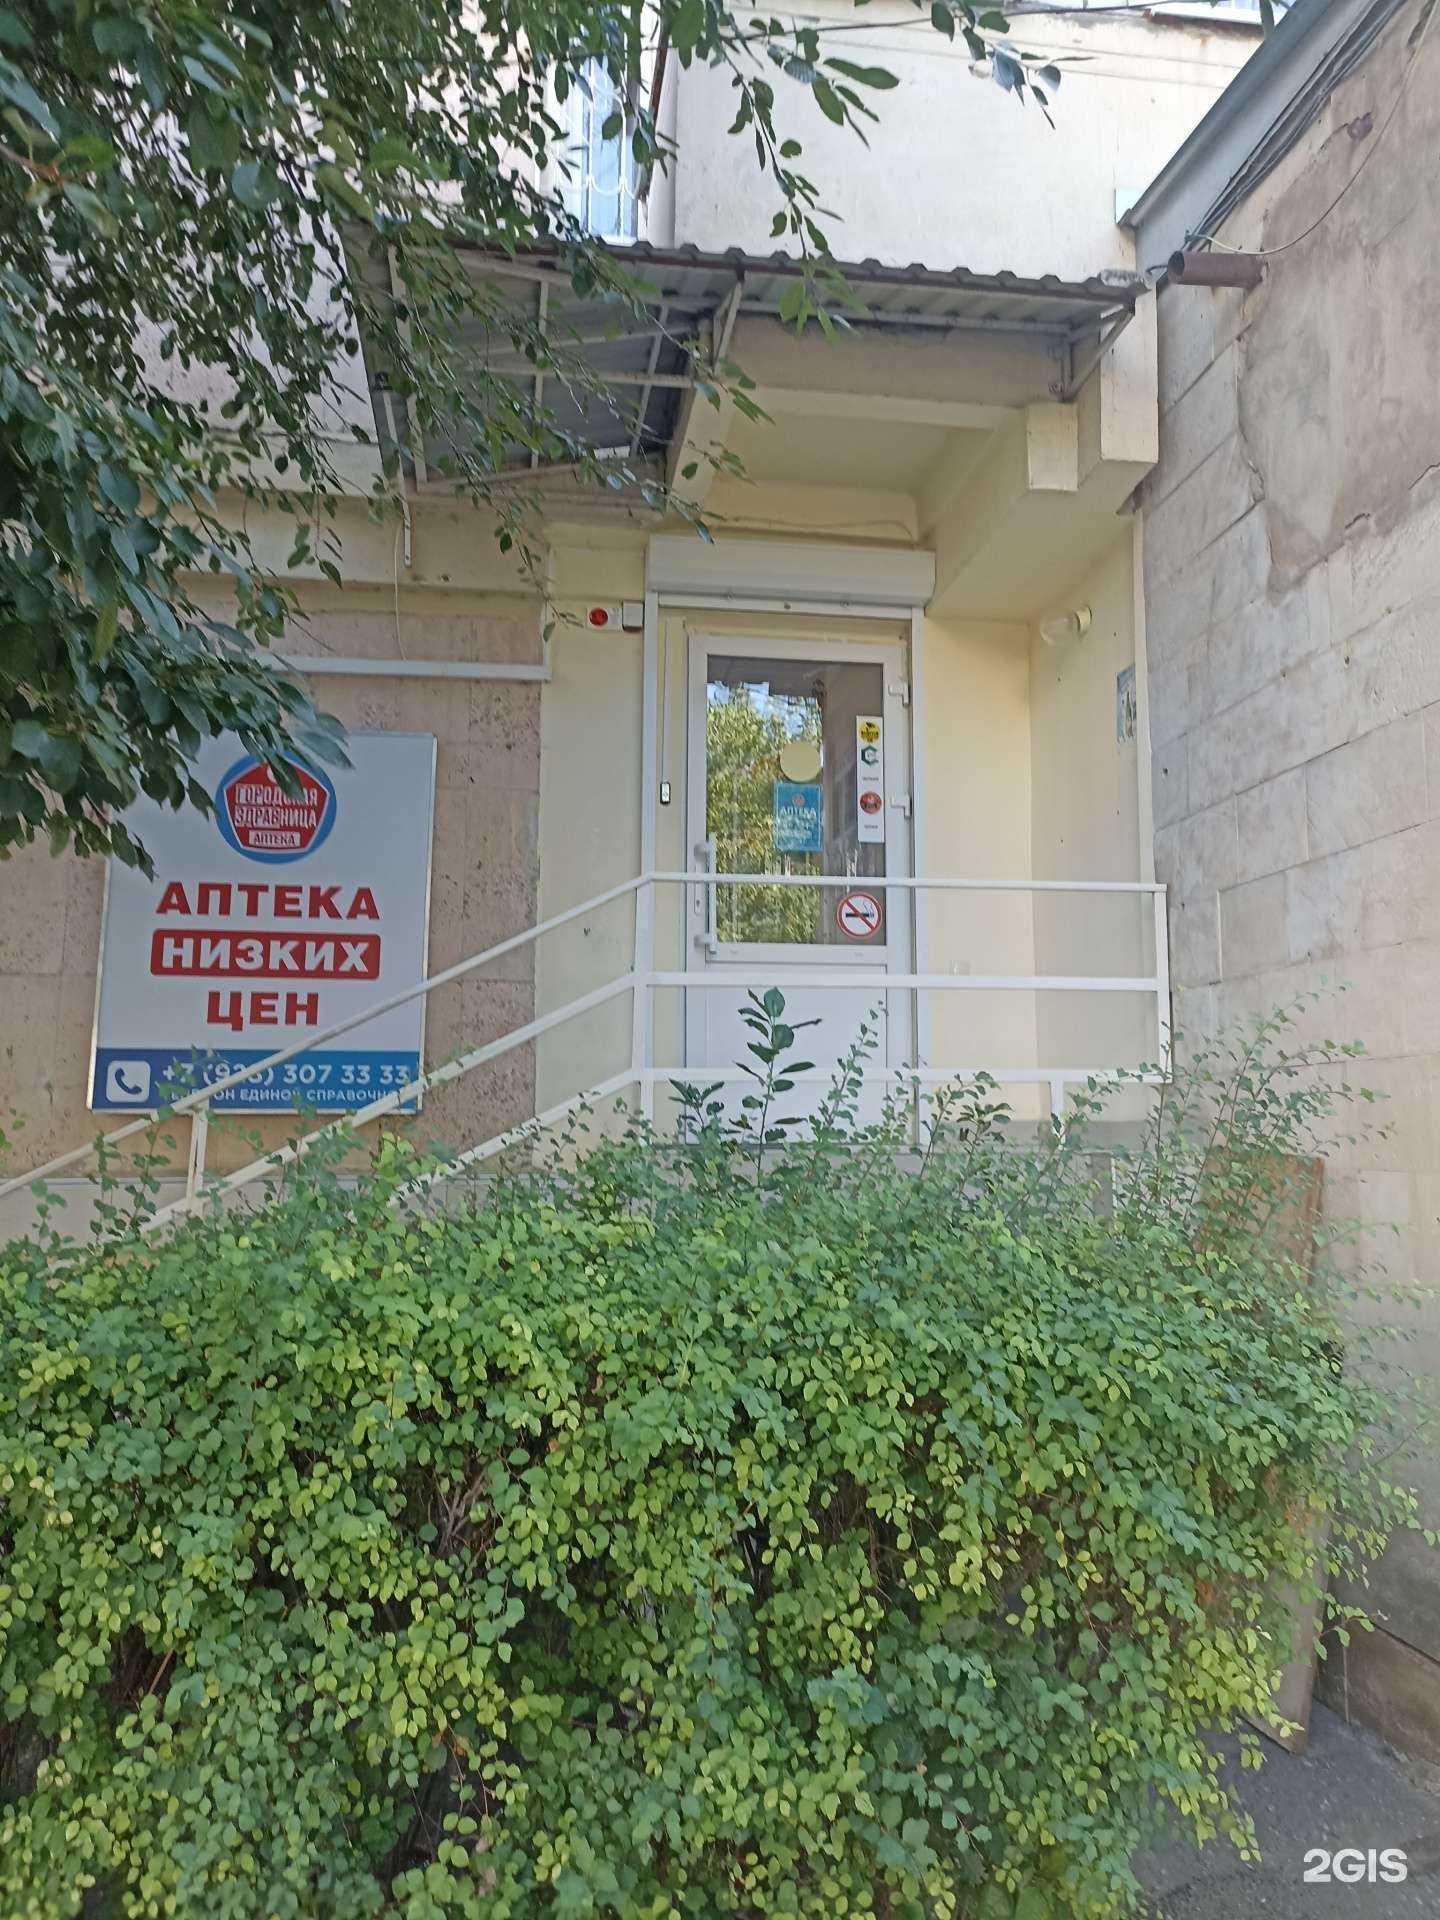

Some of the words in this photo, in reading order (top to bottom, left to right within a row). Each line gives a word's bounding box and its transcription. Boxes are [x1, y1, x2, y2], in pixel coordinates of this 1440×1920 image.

[155, 881, 380, 920] АПТЕКА
[162, 937, 370, 973] НИЗКИХ
[206, 991, 319, 1031] ЦЕН
[282, 1063, 332, 1085] 307
[340, 1064, 371, 1085] 33
[379, 1064, 410, 1085] 33
